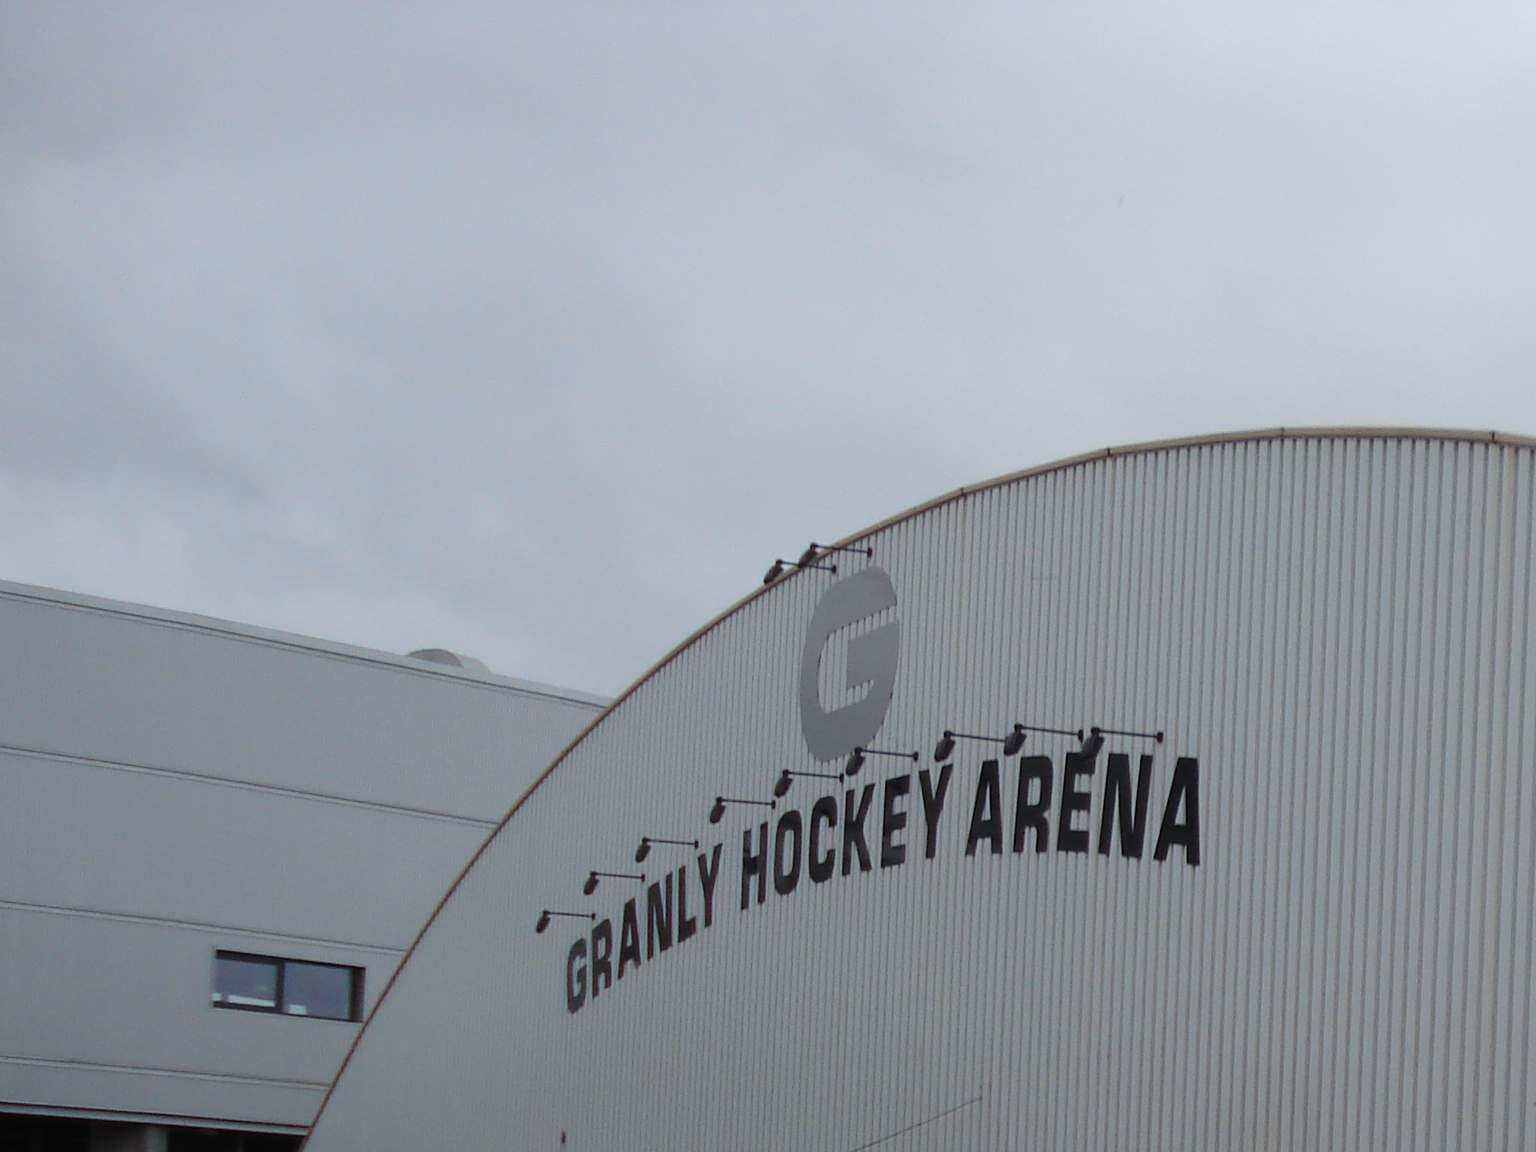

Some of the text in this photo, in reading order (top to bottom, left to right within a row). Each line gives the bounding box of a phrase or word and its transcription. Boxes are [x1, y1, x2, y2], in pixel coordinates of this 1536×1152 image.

[566, 752, 1200, 1014] GRANLY HOCKEY ARENA
